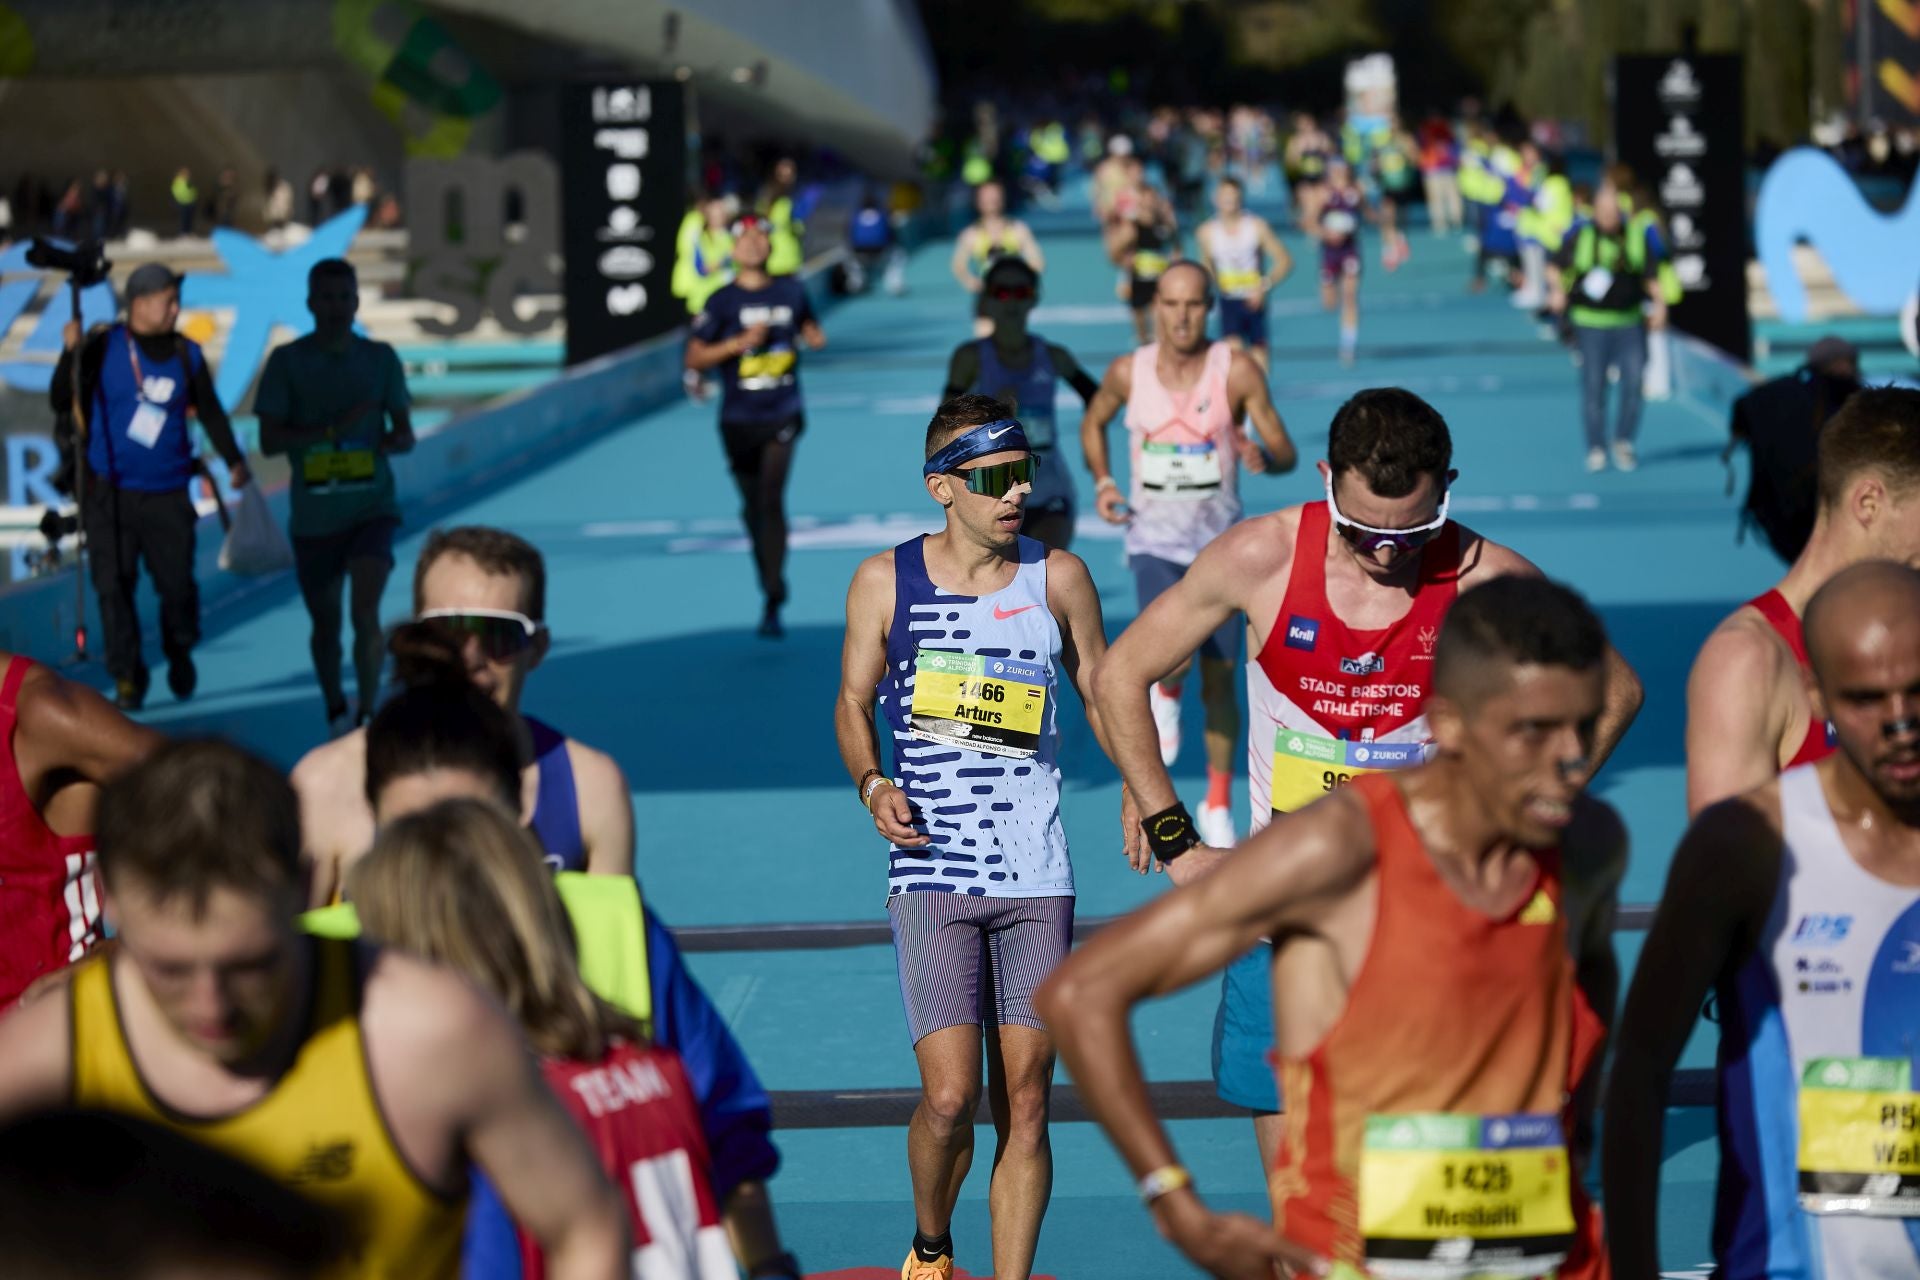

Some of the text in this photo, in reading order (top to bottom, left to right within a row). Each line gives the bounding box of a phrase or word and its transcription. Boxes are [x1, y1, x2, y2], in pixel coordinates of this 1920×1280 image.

[1289, 626, 1315, 642] Krill
[1006, 666, 1036, 677] ZURICH
[959, 681, 1005, 703] 1466
[1299, 677, 1421, 698] STADE BRESTOIS
[955, 704, 1003, 724] Arturs
[1313, 698, 1404, 717] ATHLÉTISME
[981, 735, 1003, 743] balance
[1372, 751, 1408, 760] ZURICH
[570, 1057, 672, 1117] TEAM
